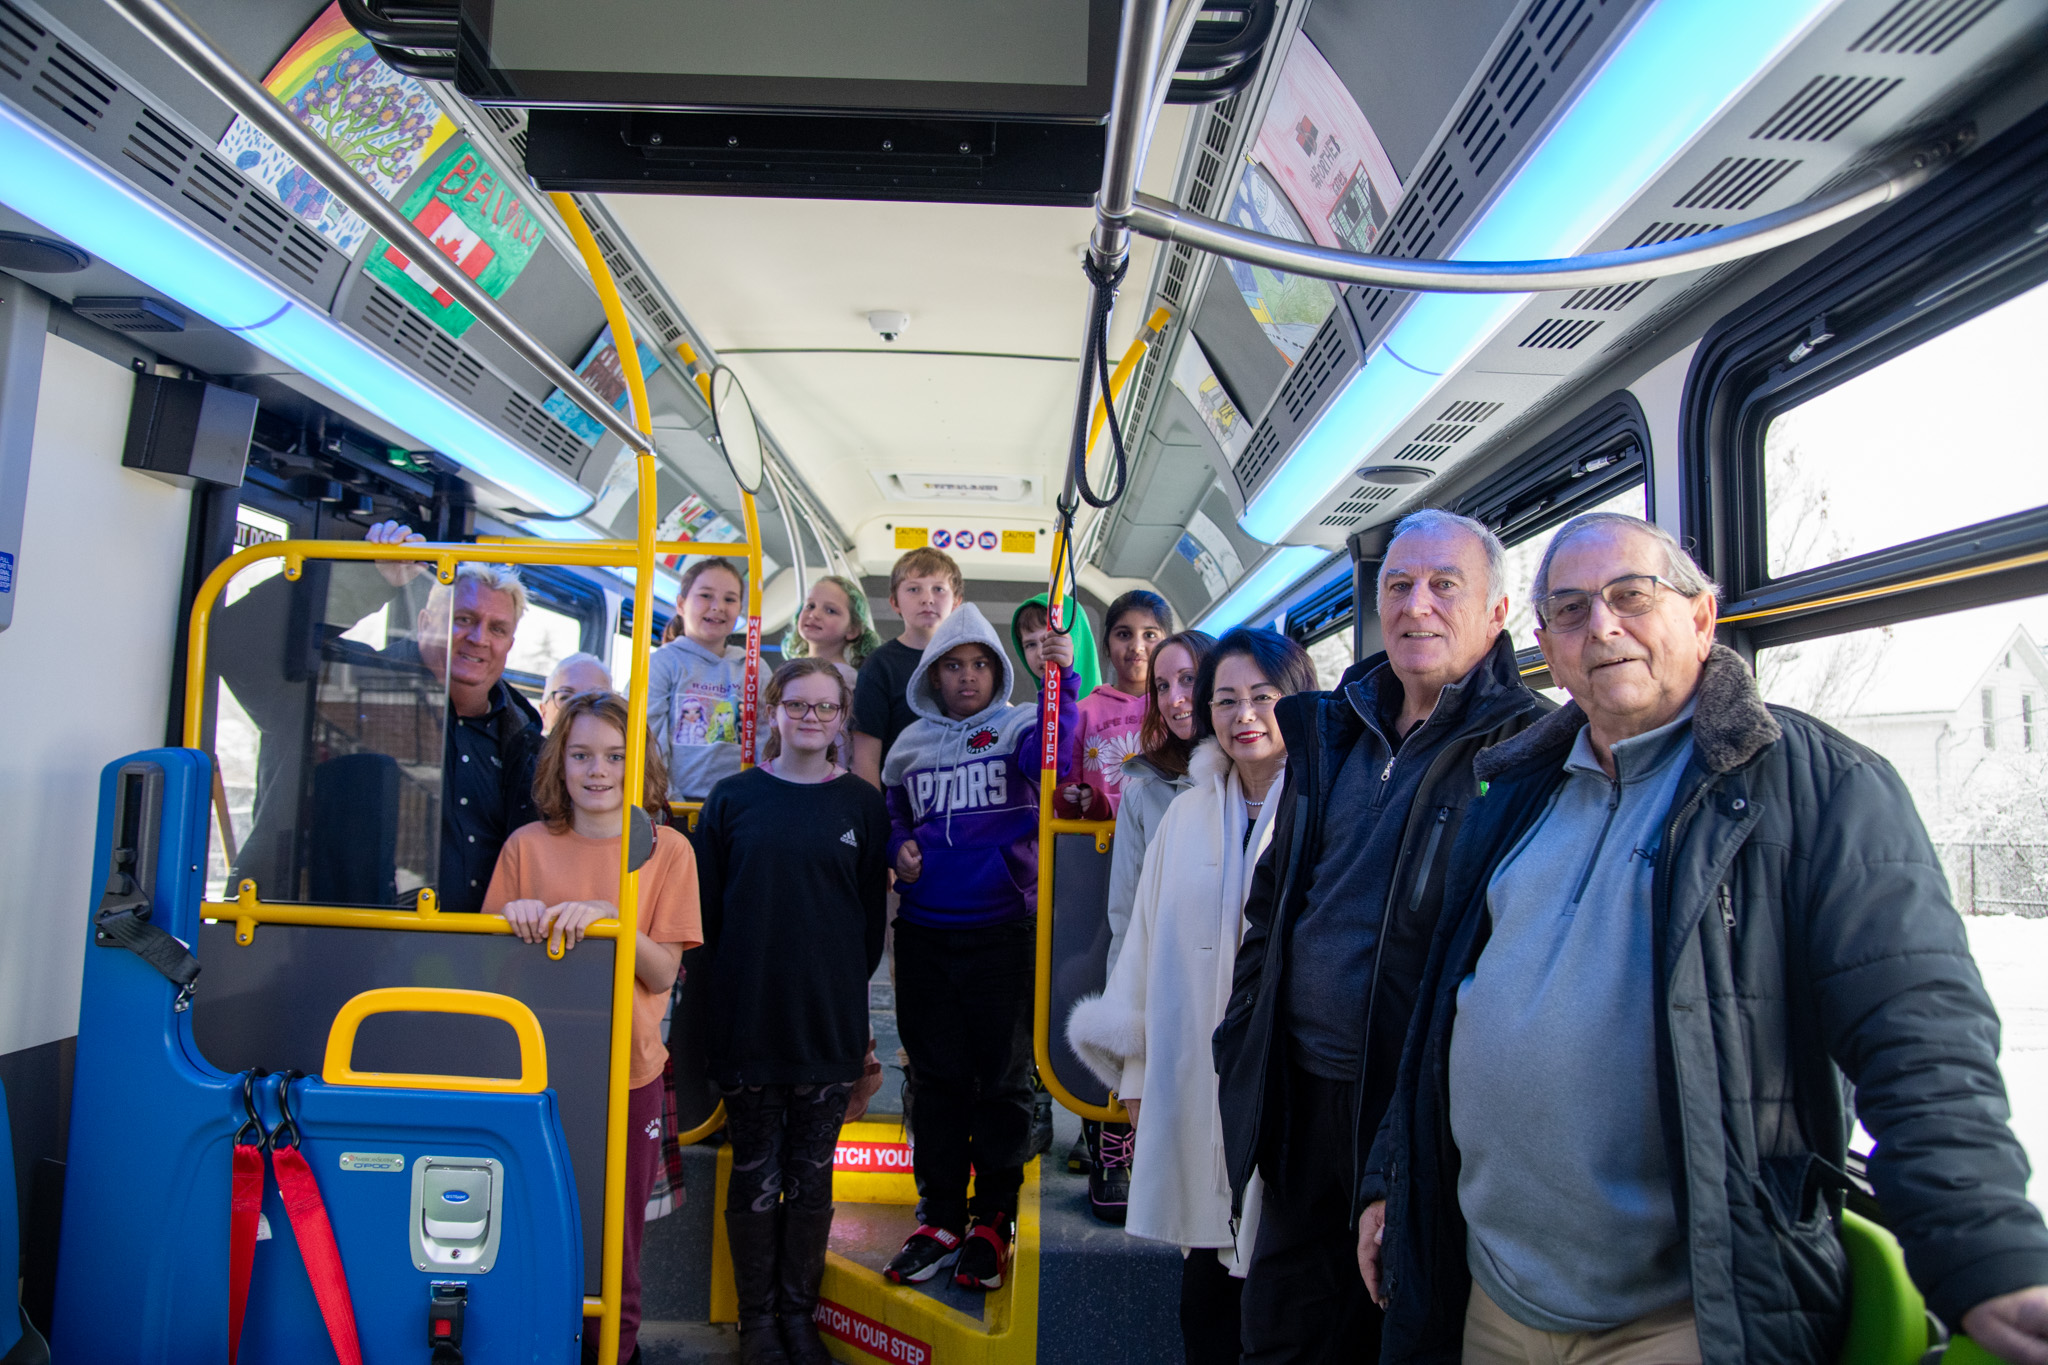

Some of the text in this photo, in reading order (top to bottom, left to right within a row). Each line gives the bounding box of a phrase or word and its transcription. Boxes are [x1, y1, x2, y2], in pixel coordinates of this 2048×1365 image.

[1002, 531, 1034, 539] CAUTION
[745, 619, 759, 758] WATCH YOUR STEP
[1046, 670, 1057, 764] YOUR STEP
[1097, 717, 1121, 732] LIFE
[1126, 715, 1137, 724] IS
[853, 1319, 888, 1352] YOUR
[891, 1337, 925, 1365] STEP
